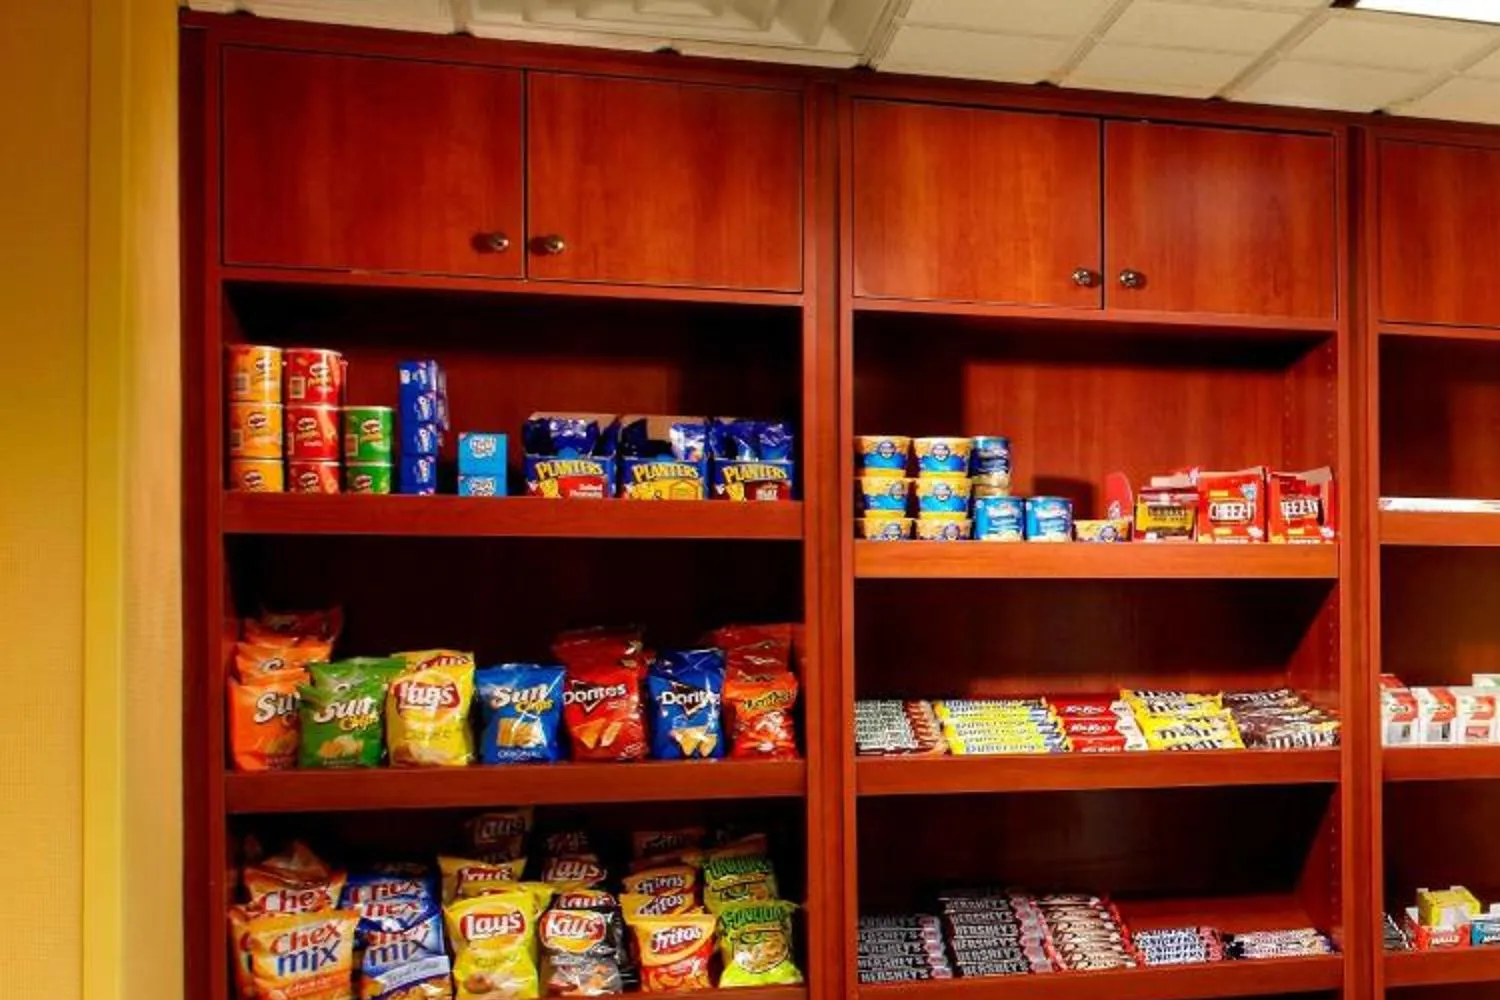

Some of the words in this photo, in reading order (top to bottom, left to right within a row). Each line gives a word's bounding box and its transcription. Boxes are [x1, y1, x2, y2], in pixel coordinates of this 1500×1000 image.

[535, 459, 604, 482] PLANTERS
[632, 462, 700, 484] PLANTERS
[722, 463, 788, 485] PLANTERS
[491, 684, 550, 709] Sun
[564, 683, 627, 704] Doritos
[270, 923, 339, 955] Chex
[651, 925, 702, 952] Fritos
[277, 940, 338, 977] mix
[367, 940, 428, 967] mix
